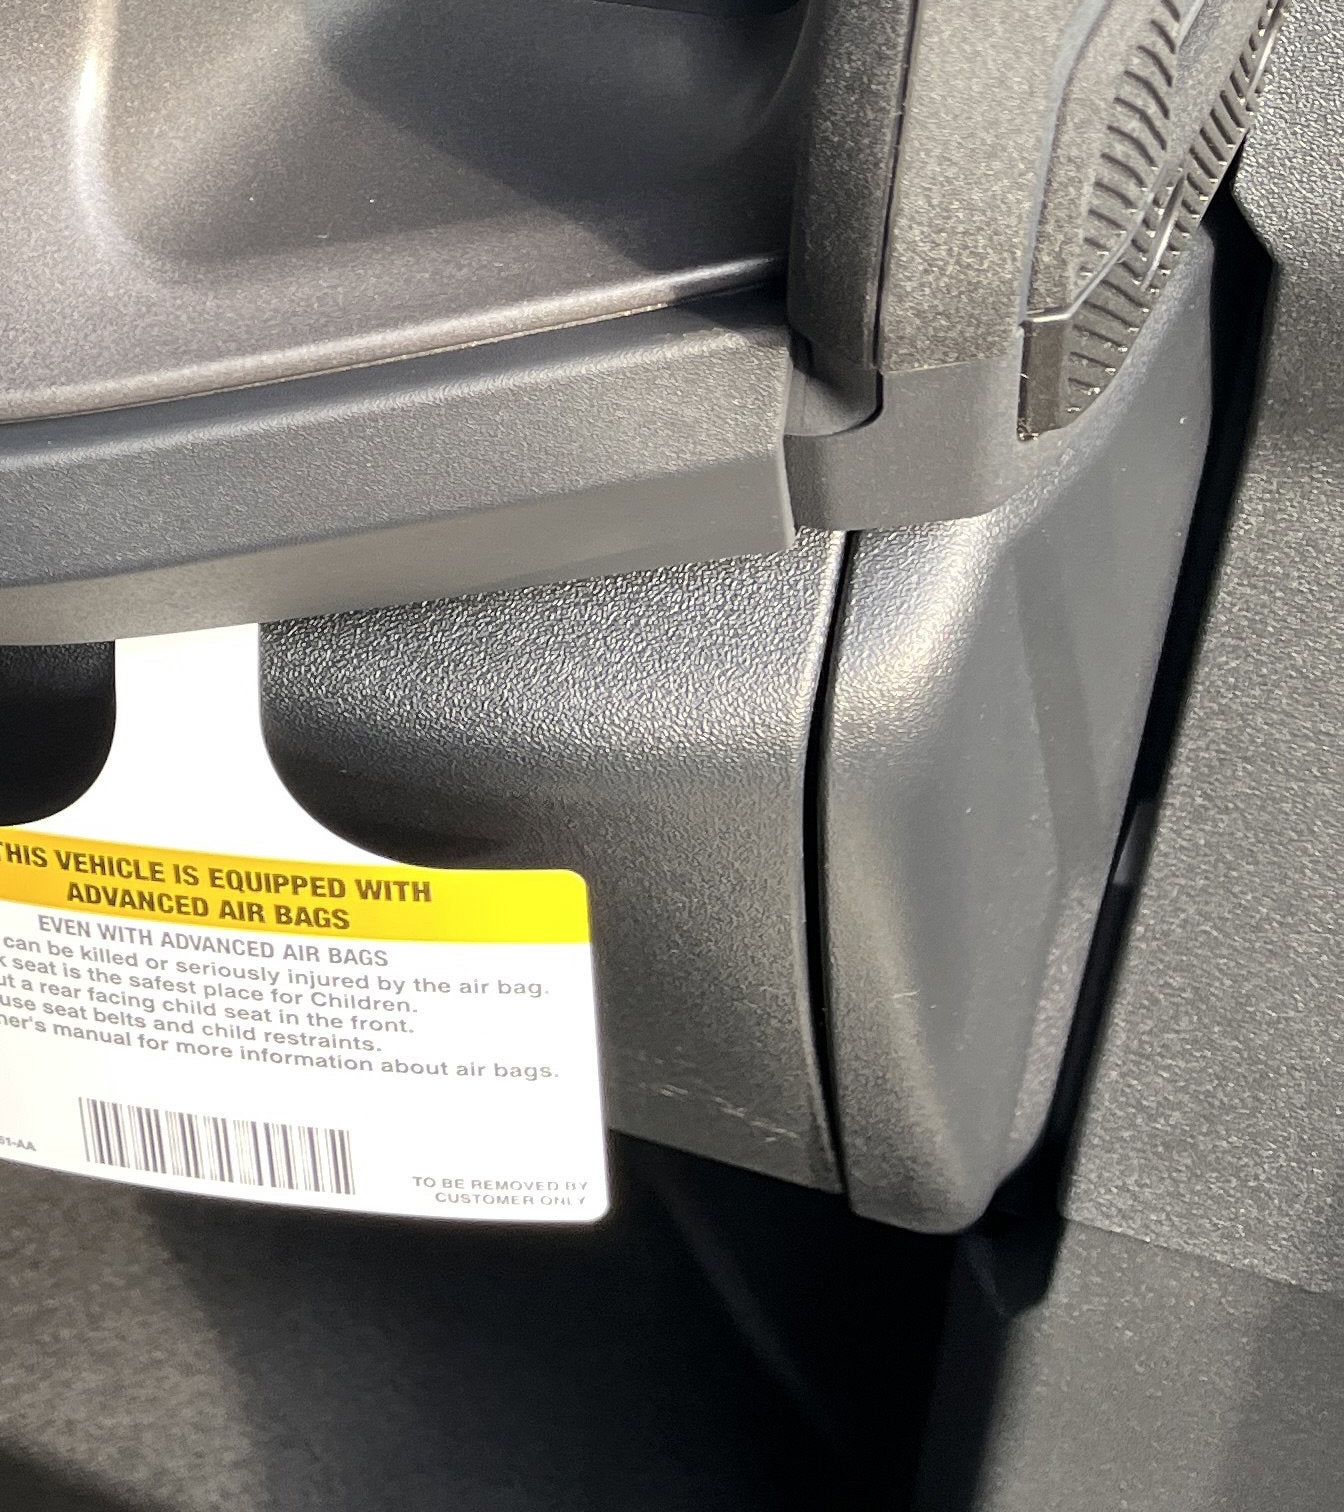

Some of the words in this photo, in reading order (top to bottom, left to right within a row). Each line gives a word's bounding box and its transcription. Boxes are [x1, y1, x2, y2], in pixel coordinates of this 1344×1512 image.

[54, 849, 166, 884] VEHICLE
[173, 863, 200, 887] IS
[208, 867, 347, 899] EQUIPPED
[355, 878, 432, 903] WITH
[67, 881, 210, 917] ADVANCED
[218, 899, 266, 924] AIR
[275, 904, 350, 930] BAGS
[3, 936, 42, 954] can
[48, 940, 74, 958] be
[81, 944, 138, 968] killed
[145, 956, 169, 971] or
[176, 960, 281, 986] seriously
[288, 968, 370, 990] injured
[378, 975, 406, 995] by
[413, 977, 451, 994] the
[459, 978, 490, 995] air
[498, 979, 550, 999] bag.
[37, 914, 91, 938] EVEN
[97, 922, 154, 946] WITH
[160, 931, 275, 959] ADVANCED
[282, 944, 321, 963] AIR
[328, 947, 389, 967] BAGS
[12, 958, 58, 978] seat
[62, 962, 82, 980] is
[87, 965, 123, 986] the
[129, 974, 197, 996] safest
[203, 982, 264, 1003] place
[270, 988, 304, 1005] for
[311, 991, 418, 1014] Children.
[21, 977, 33, 992] a
[40, 980, 82, 1000] rear
[88, 985, 156, 1014] facing
[162, 998, 217, 1018] child
[224, 1004, 273, 1023] seat
[279, 1008, 300, 1026] in
[306, 1011, 344, 1029] the
[351, 1015, 415, 1034] front.
[0, 992, 37, 1011] use
[43, 1001, 89, 1021] seat
[93, 1006, 147, 1029] belts
[153, 1017, 195, 1035] and
[202, 1022, 256, 1041] child
[264, 1030, 382, 1052] restraints.
[53, 1022, 132, 1048] manual
[137, 1033, 170, 1051] for
[176, 1041, 234, 1059] more
[240, 1045, 374, 1072] information
[381, 1059, 449, 1076] about
[456, 1061, 486, 1077] air
[494, 1062, 559, 1083] bags.
[412, 1176, 437, 1189] TO
[442, 1178, 465, 1189] BE
[471, 1179, 559, 1192] REMOVED
[566, 1181, 588, 1191] BY
